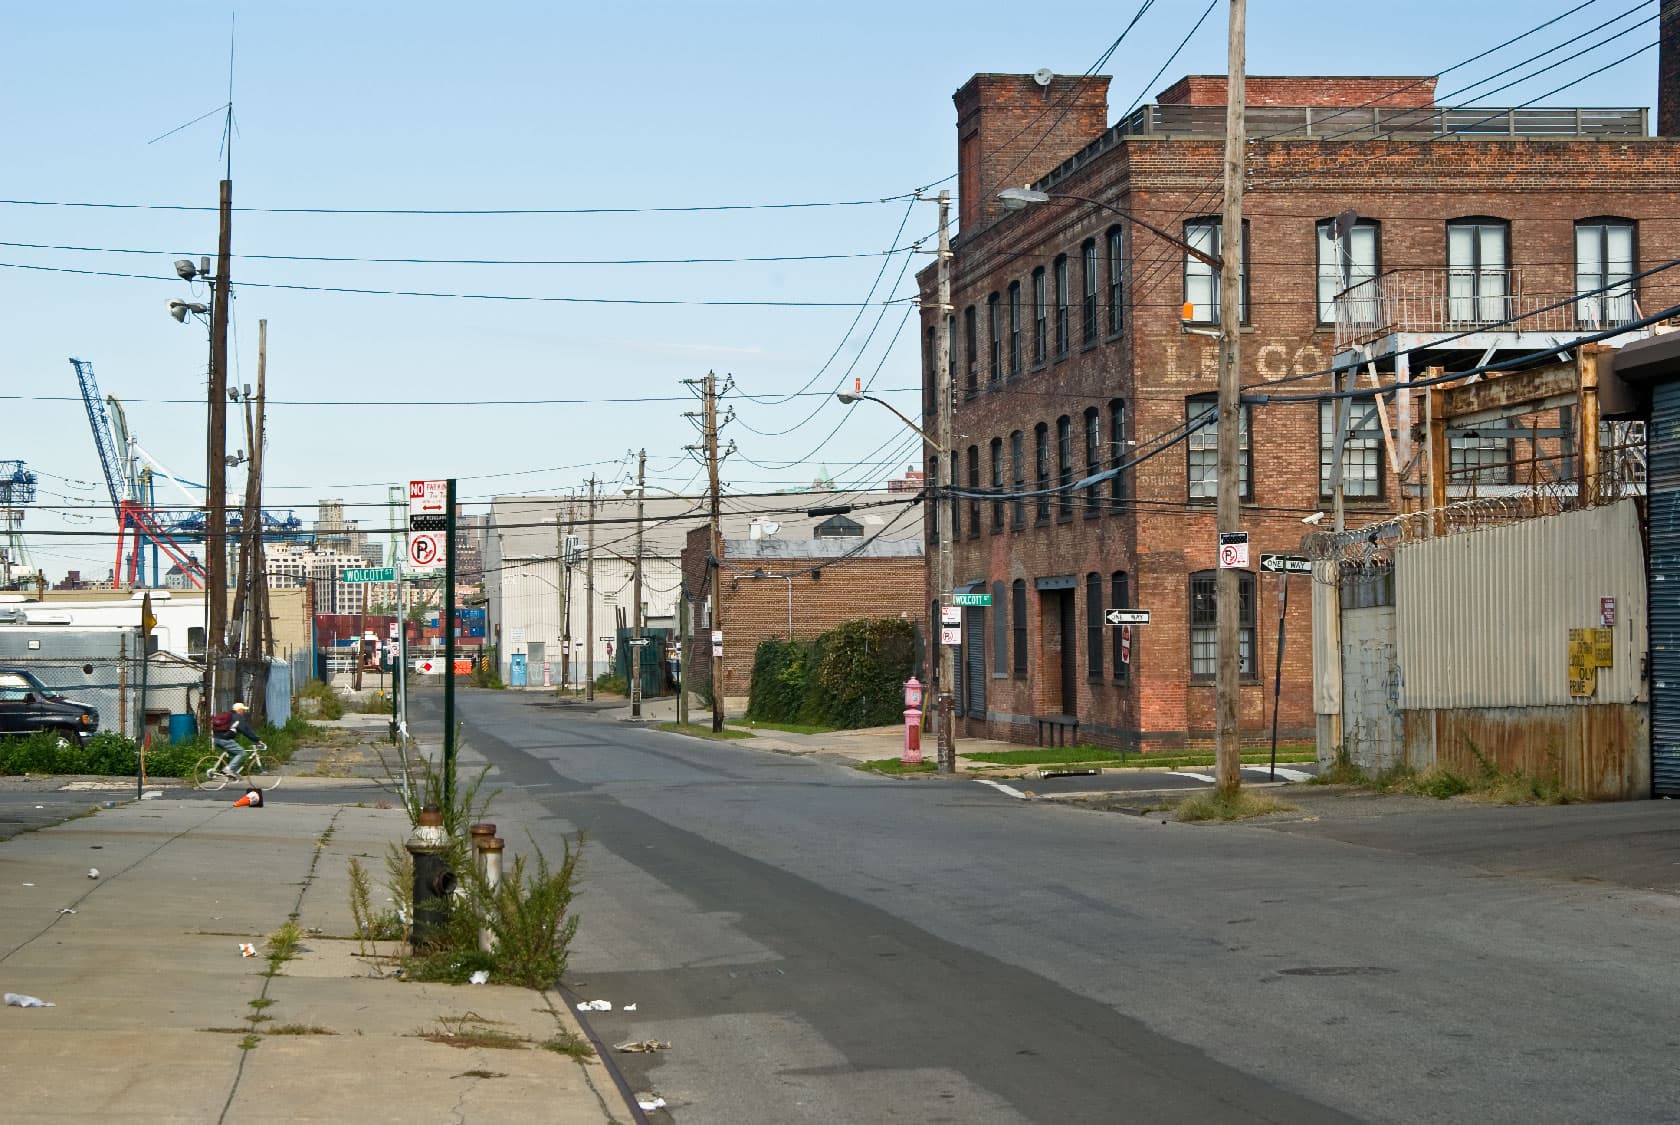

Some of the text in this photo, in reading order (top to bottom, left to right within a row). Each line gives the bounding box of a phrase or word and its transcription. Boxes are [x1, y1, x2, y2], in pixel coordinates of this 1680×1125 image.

[411, 483, 423, 496] NO
[1267, 560, 1304, 569] ONE WAY
[346, 569, 384, 581] WOLCOTT
[954, 595, 982, 605] WOLCOTT
